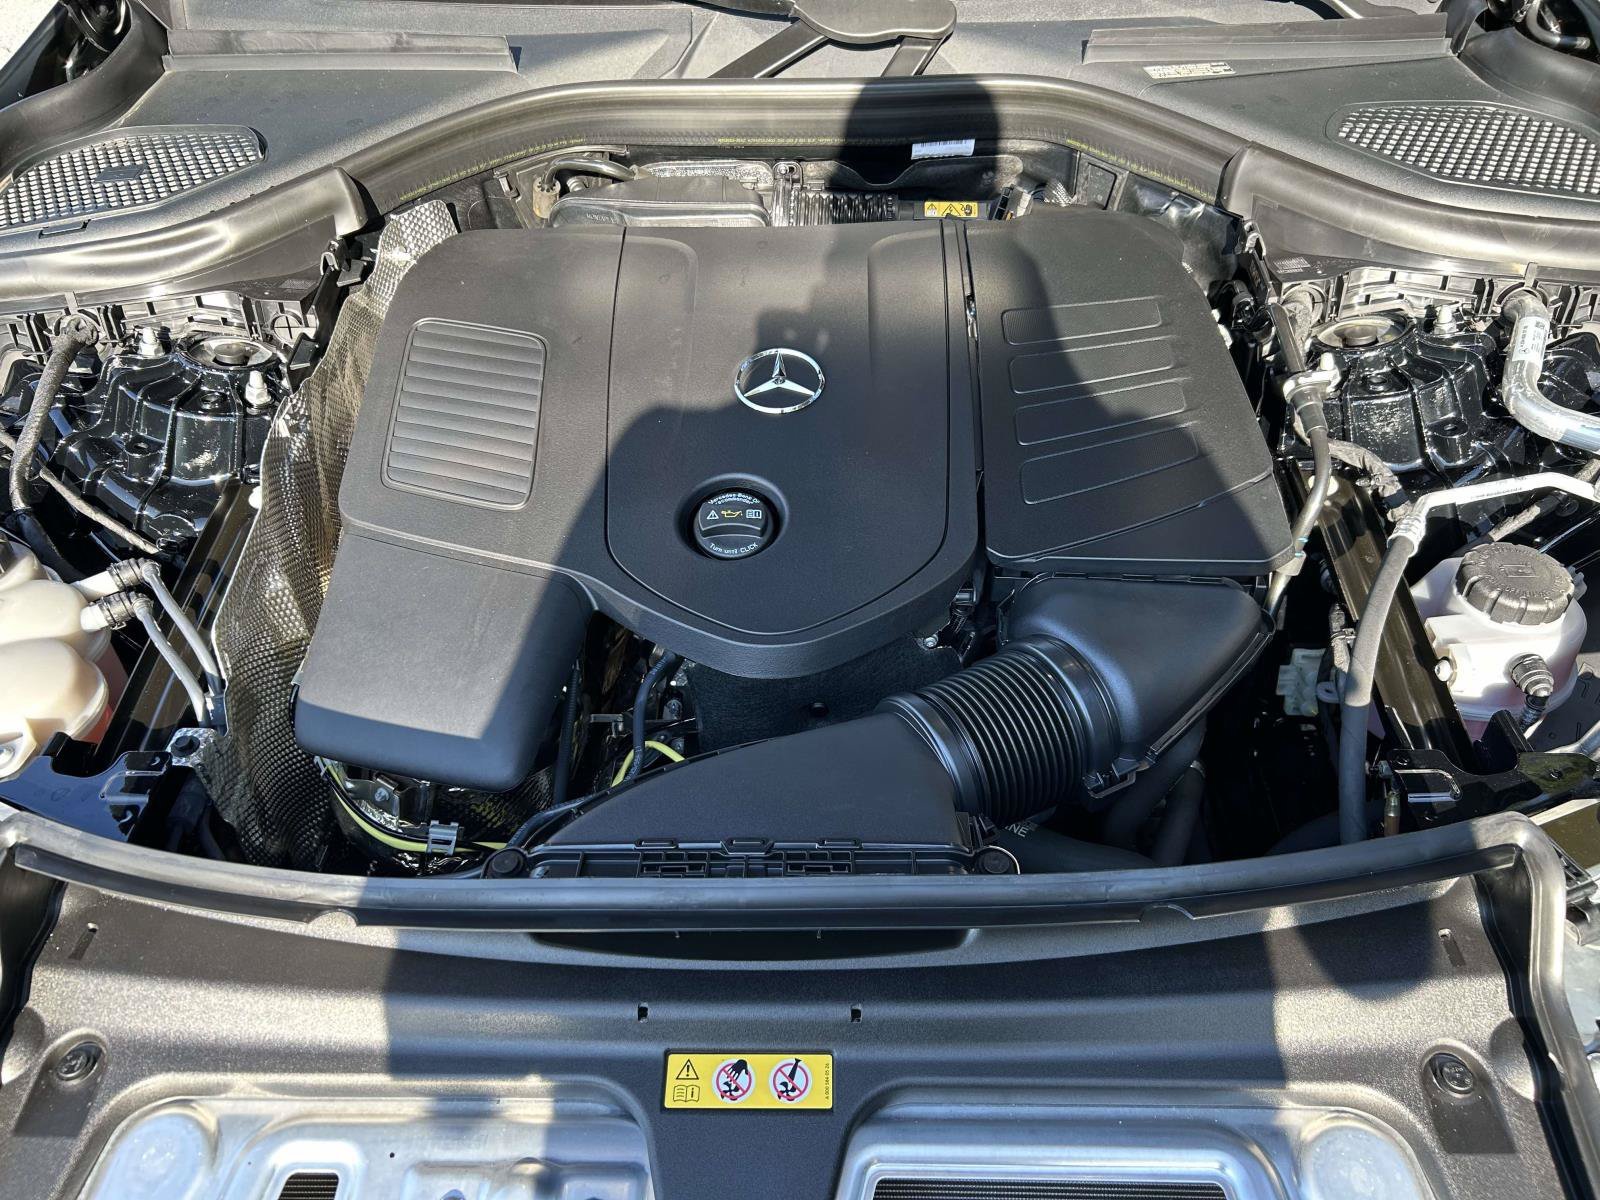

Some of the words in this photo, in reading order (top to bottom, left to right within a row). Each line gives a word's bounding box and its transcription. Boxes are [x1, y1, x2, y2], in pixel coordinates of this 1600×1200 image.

[710, 543, 722, 553] Turn
[740, 542, 758, 553] CLICK
[1004, 824, 1029, 838] NE
